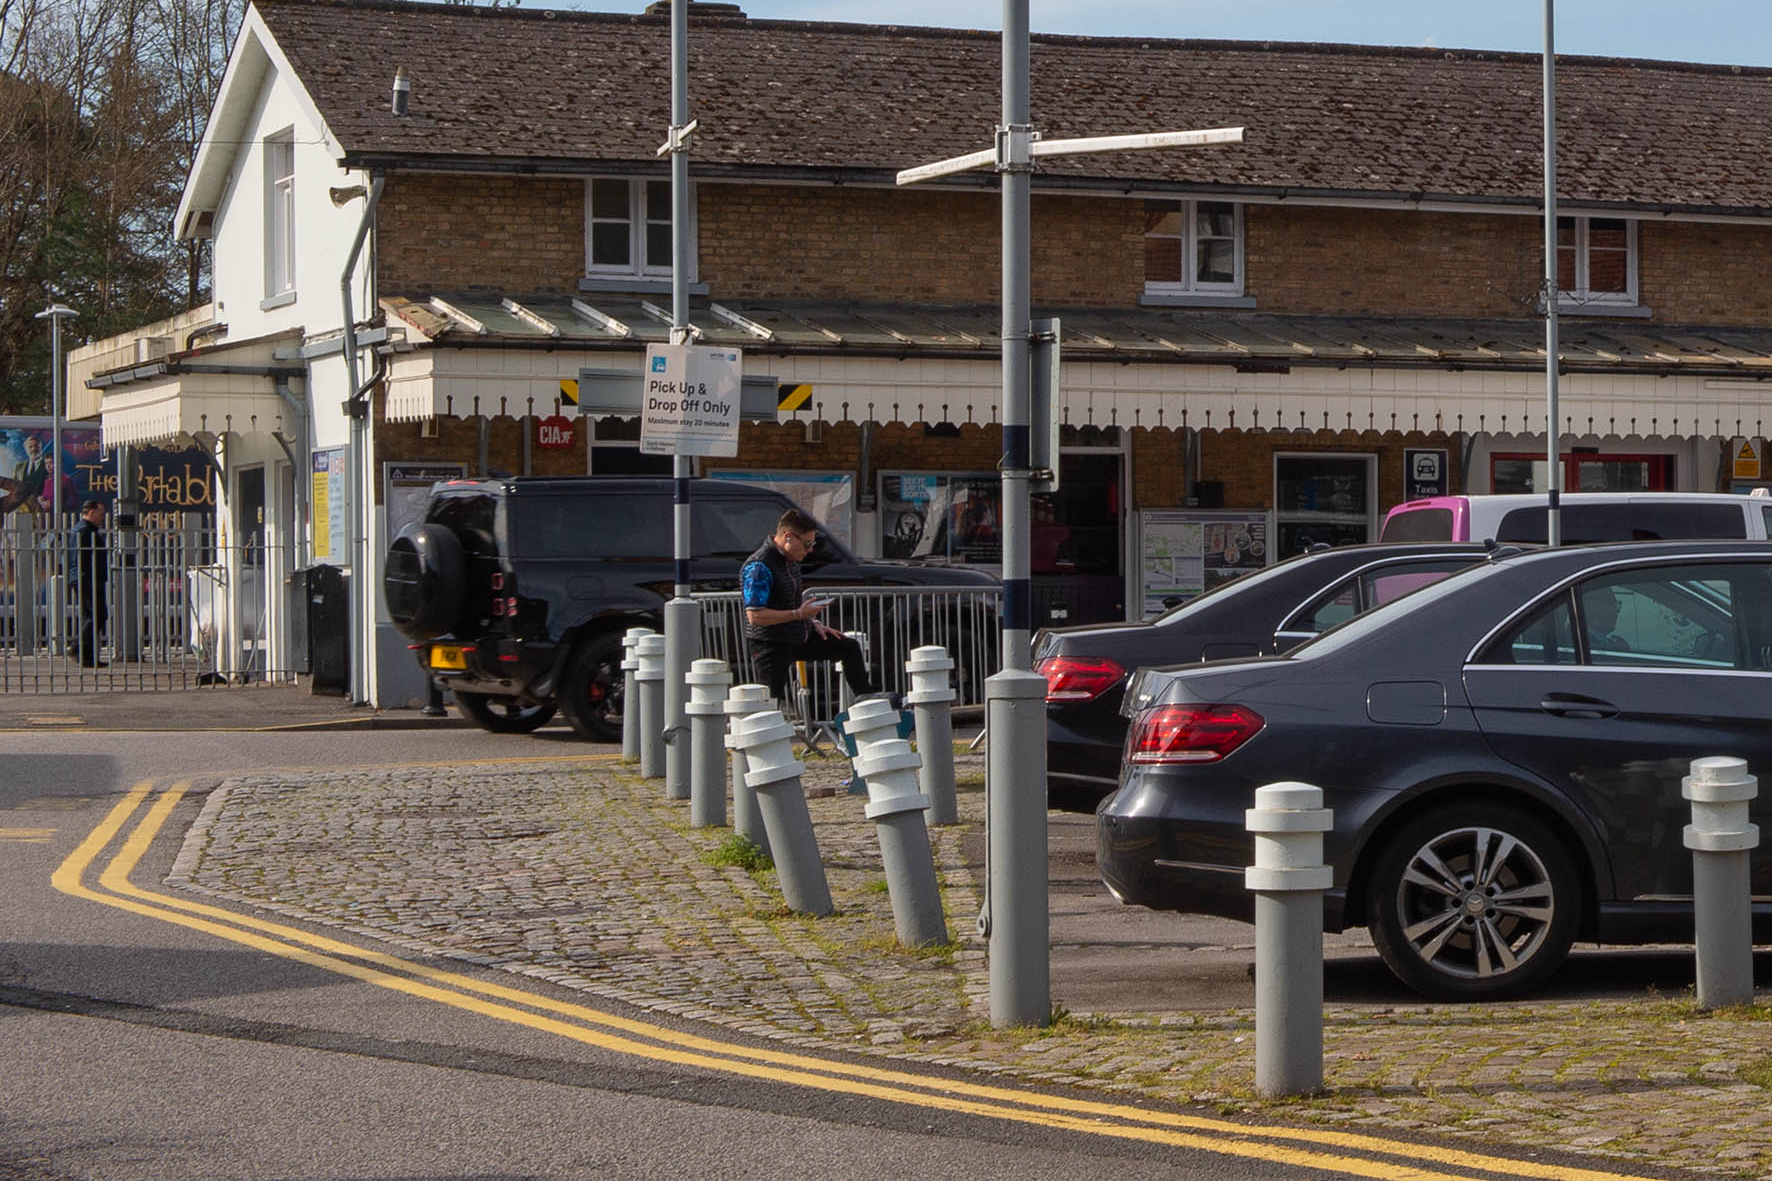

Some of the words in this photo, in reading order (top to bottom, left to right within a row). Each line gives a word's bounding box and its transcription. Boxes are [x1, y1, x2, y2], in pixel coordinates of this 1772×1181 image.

[650, 380, 676, 394] Pick
[679, 382, 695, 397] Up
[698, 382, 707, 395] &
[648, 398, 677, 414] Drop
[680, 399, 701, 412] Off
[703, 400, 731, 417] Only
[648, 417, 679, 425] Maximum
[679, 419, 694, 428] stay
[703, 420, 730, 428] minutes
[1415, 484, 1438, 494] Taxis
